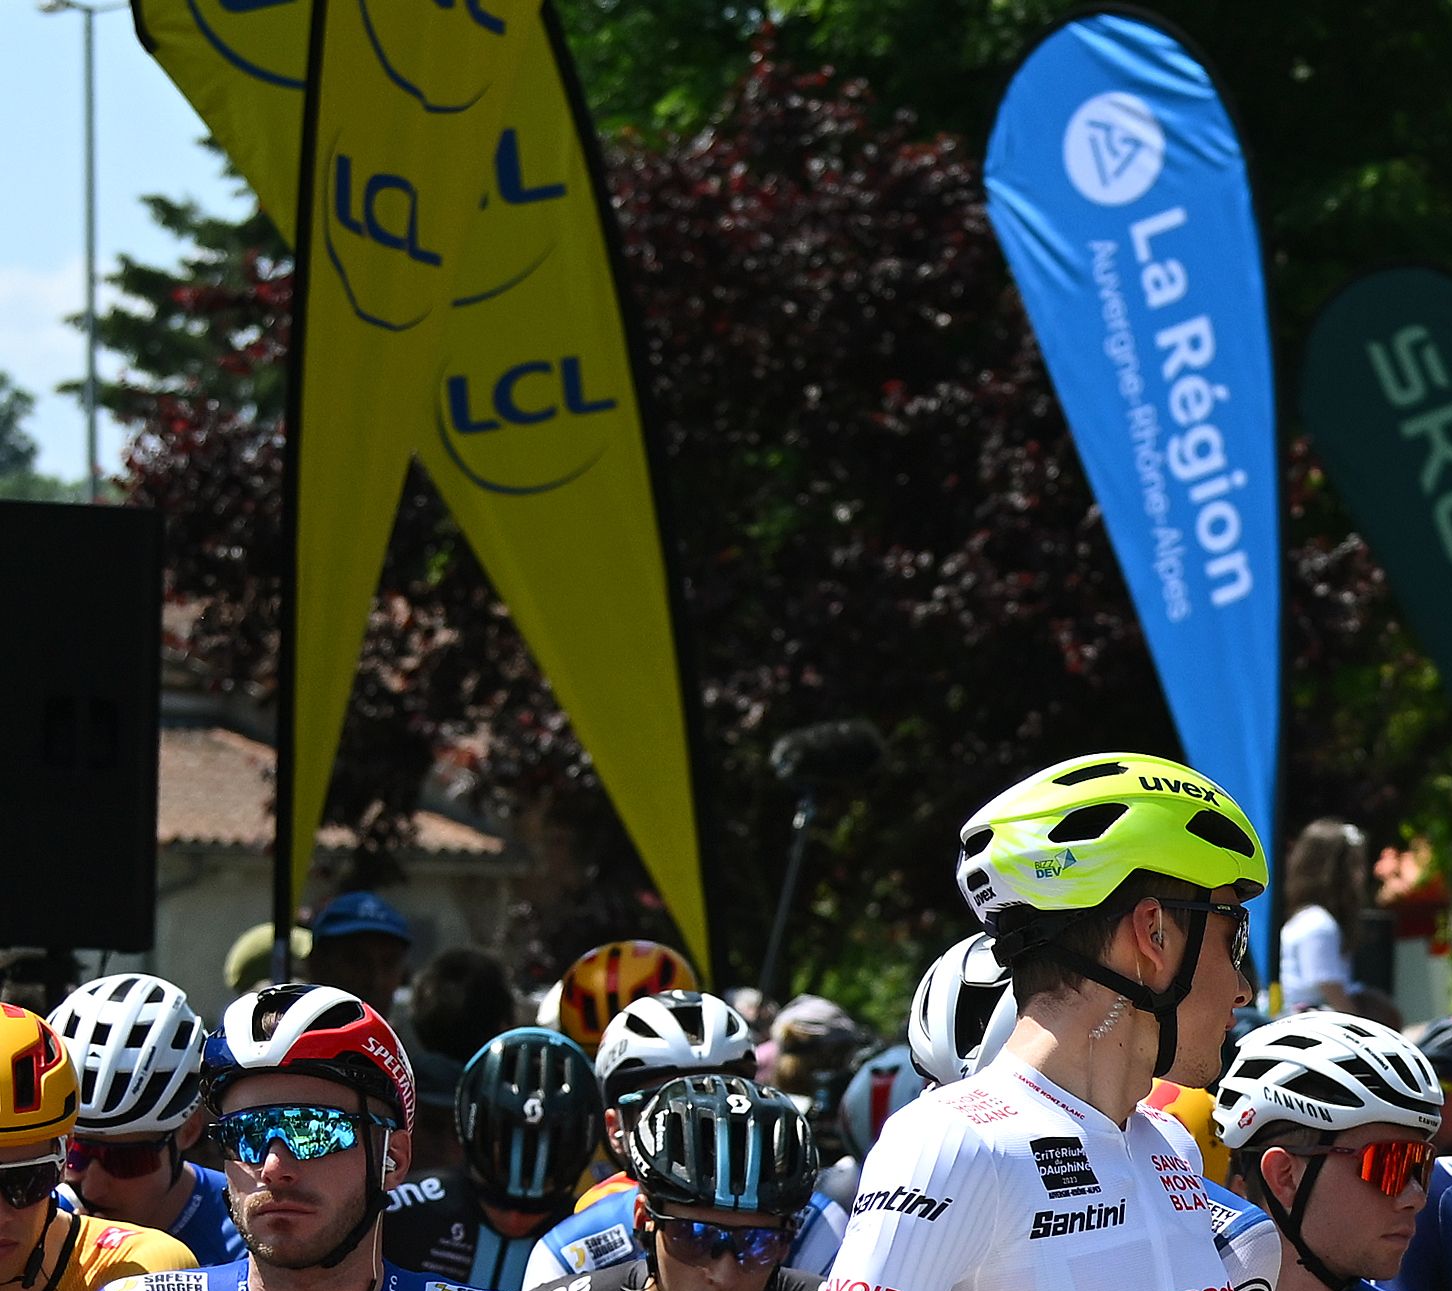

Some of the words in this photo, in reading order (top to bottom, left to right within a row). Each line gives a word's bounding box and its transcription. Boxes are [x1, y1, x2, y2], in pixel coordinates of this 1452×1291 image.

[1129, 207, 1188, 309] La
[447, 357, 617, 434] LCL
[1155, 314, 1255, 607] Région
[1139, 774, 1221, 807] uvex
[1263, 1085, 1334, 1124] CANYON
[1030, 1199, 1126, 1239] Santini
[143, 1271, 204, 1287] SAFETY
